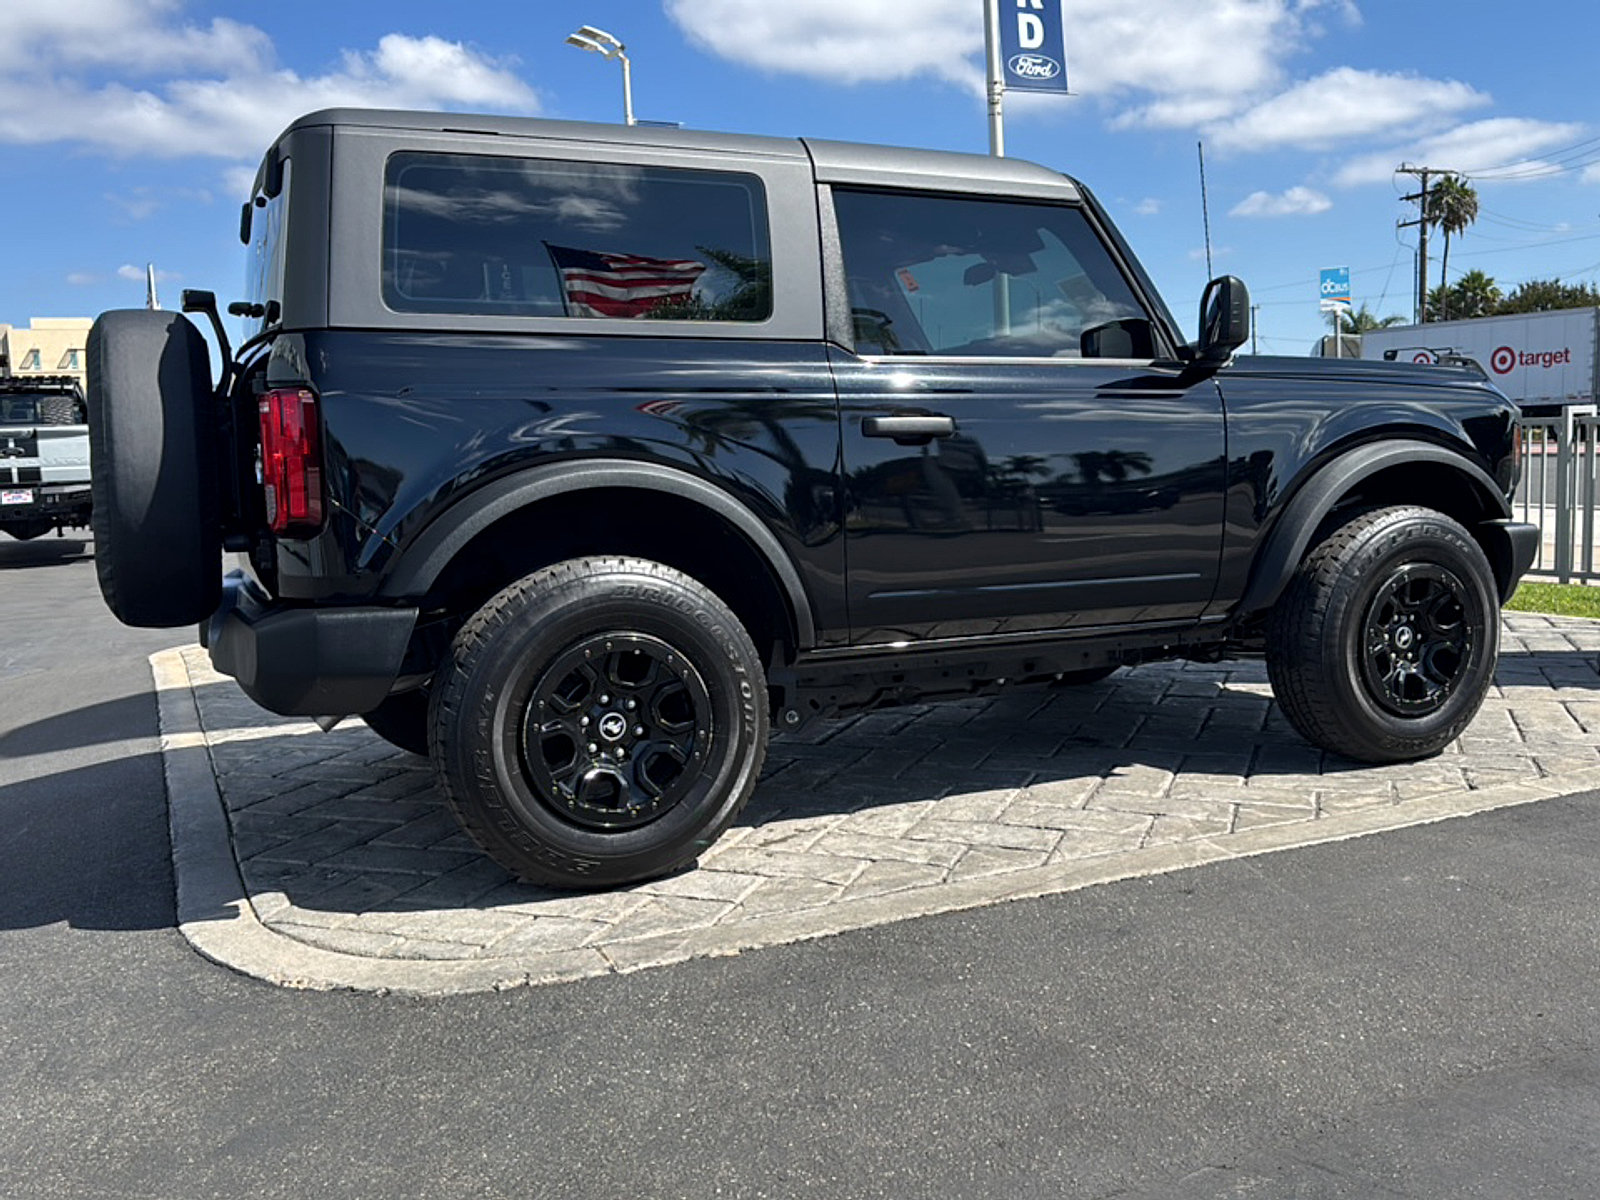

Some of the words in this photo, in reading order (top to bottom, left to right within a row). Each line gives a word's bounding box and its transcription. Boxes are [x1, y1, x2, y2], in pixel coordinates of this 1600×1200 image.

[1016, 0, 1044, 49] D
[1016, 56, 1053, 77] Ford
[1519, 347, 1571, 368] target
